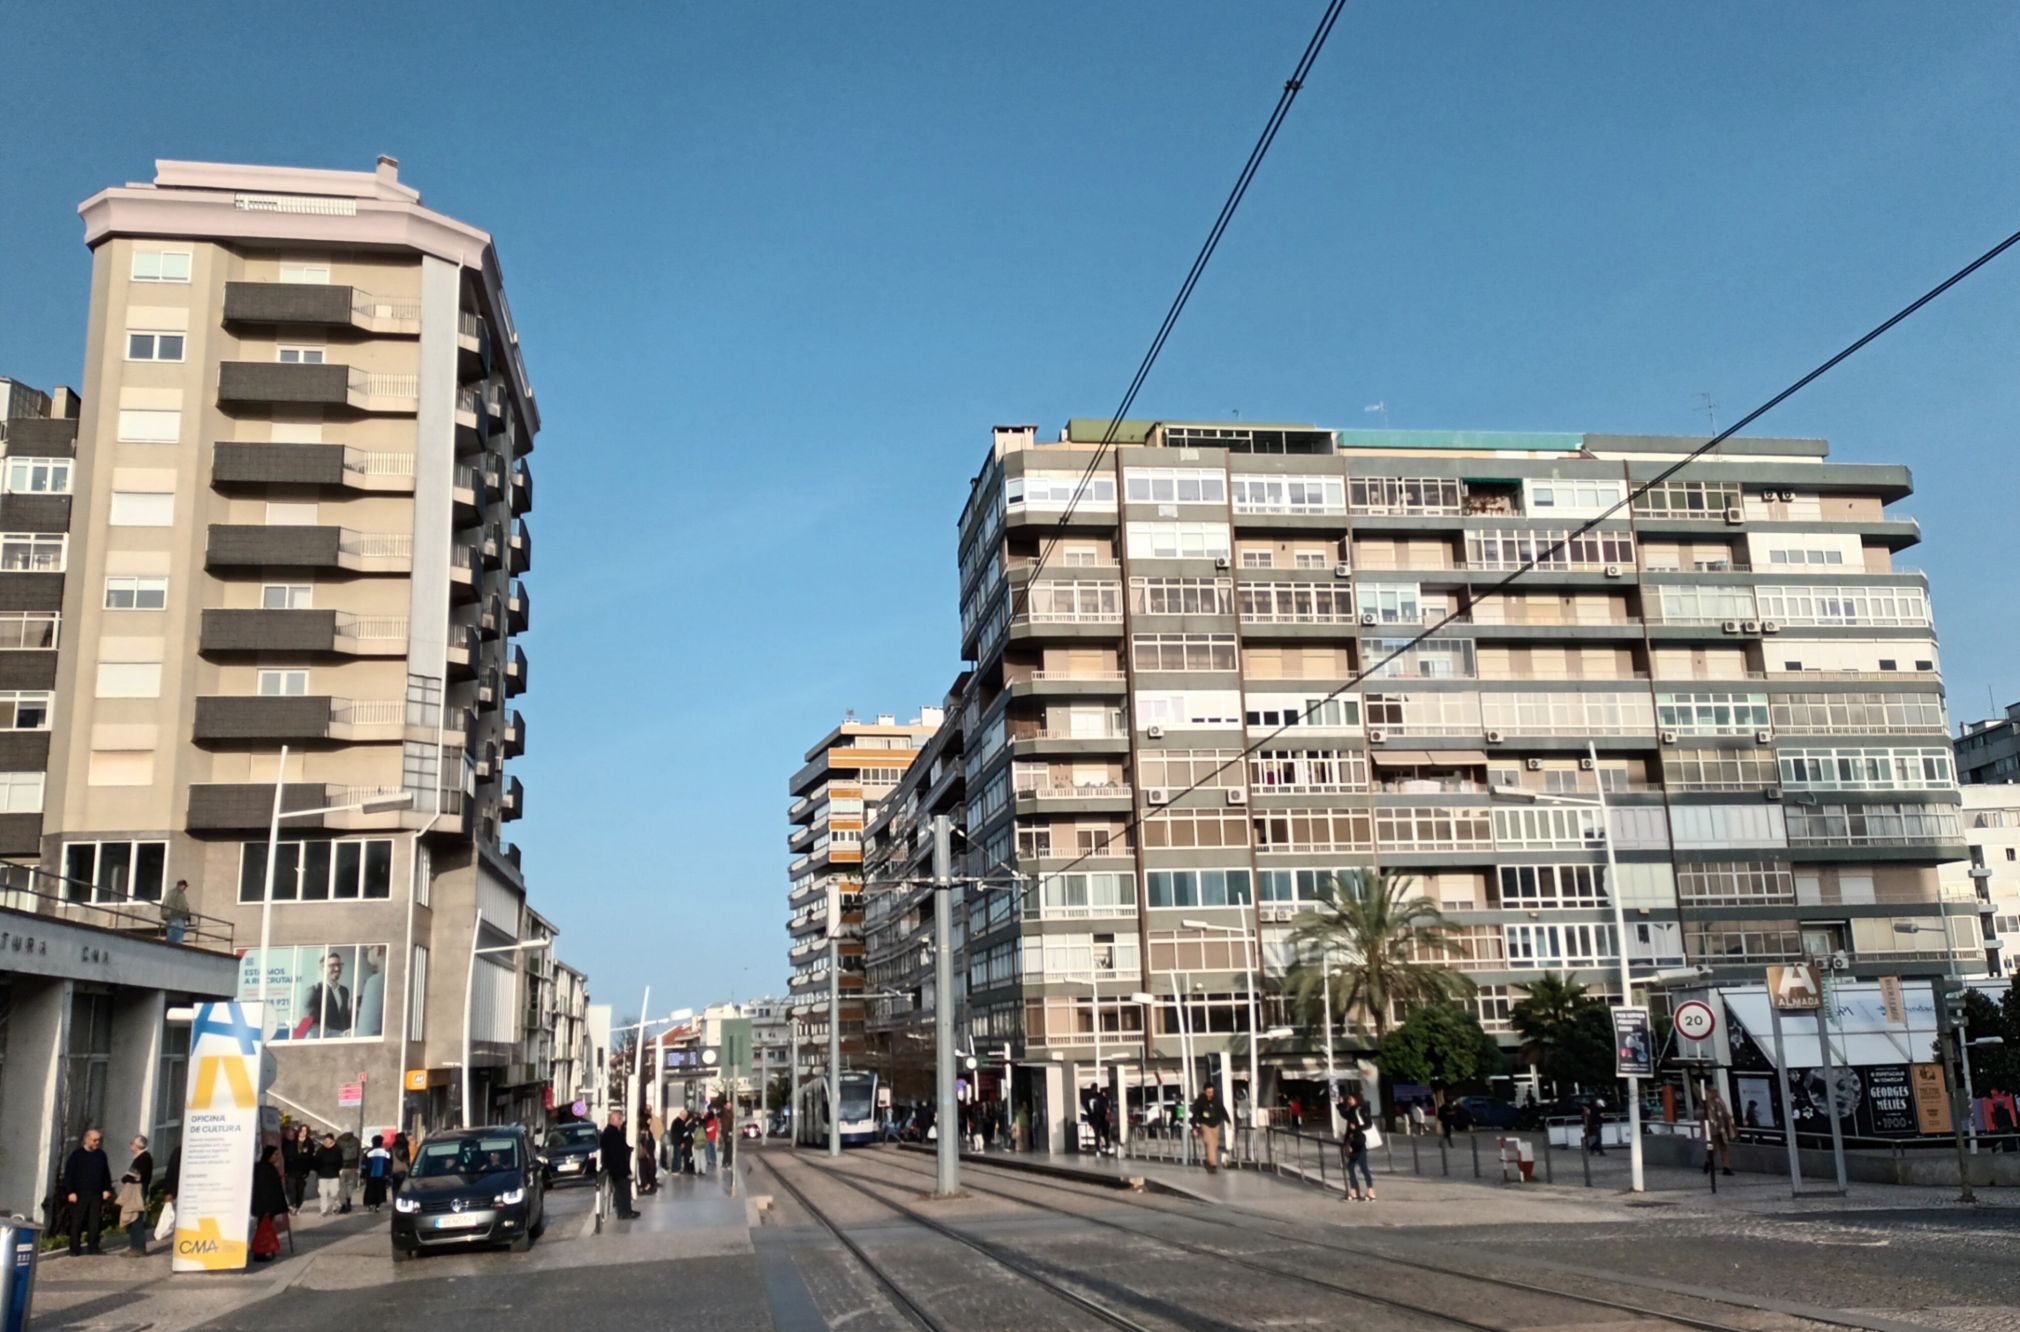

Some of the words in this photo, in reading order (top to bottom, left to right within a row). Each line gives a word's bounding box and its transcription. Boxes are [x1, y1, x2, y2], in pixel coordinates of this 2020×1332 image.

[1778, 997, 1820, 1007] ALMADA
[1684, 1015, 1703, 1026] 20
[1870, 1086, 1909, 1098] GEORGES
[191, 1114, 226, 1123] OFICINA
[1882, 1117, 1907, 1128] 1900
[190, 1126, 201, 1134] DE
[202, 1124, 241, 1133] CULTURA
[179, 1240, 219, 1255] CMA
